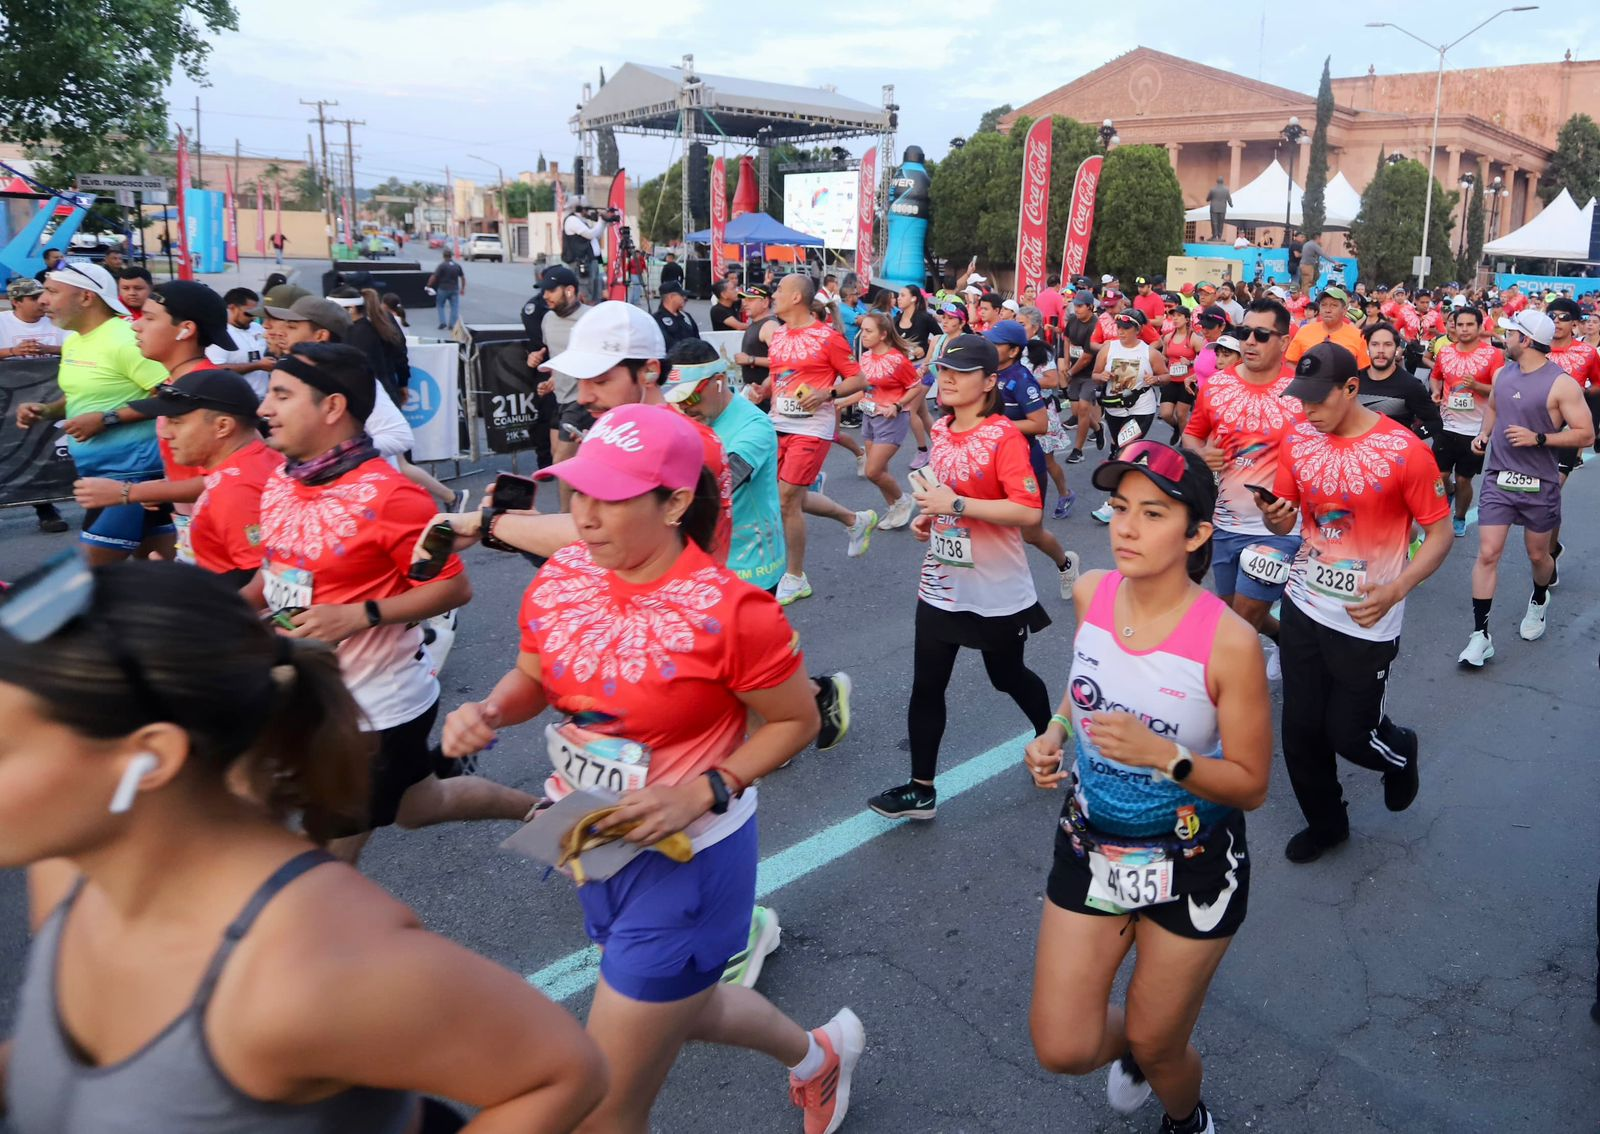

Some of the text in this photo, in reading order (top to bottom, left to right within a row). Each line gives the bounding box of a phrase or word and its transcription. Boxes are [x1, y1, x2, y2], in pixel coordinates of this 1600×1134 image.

[103, 180, 143, 188] FRANCISCO
[1025, 136, 1048, 226] Coca-Cola
[1072, 166, 1096, 237] Coca-Cola
[492, 392, 539, 418] 21K
[784, 399, 806, 413] 354
[935, 535, 963, 559] 3738
[1249, 555, 1282, 580] 4907
[1316, 565, 1355, 592] 2328
[561, 745, 623, 792] 2770
[1107, 868, 1158, 903] 4135
